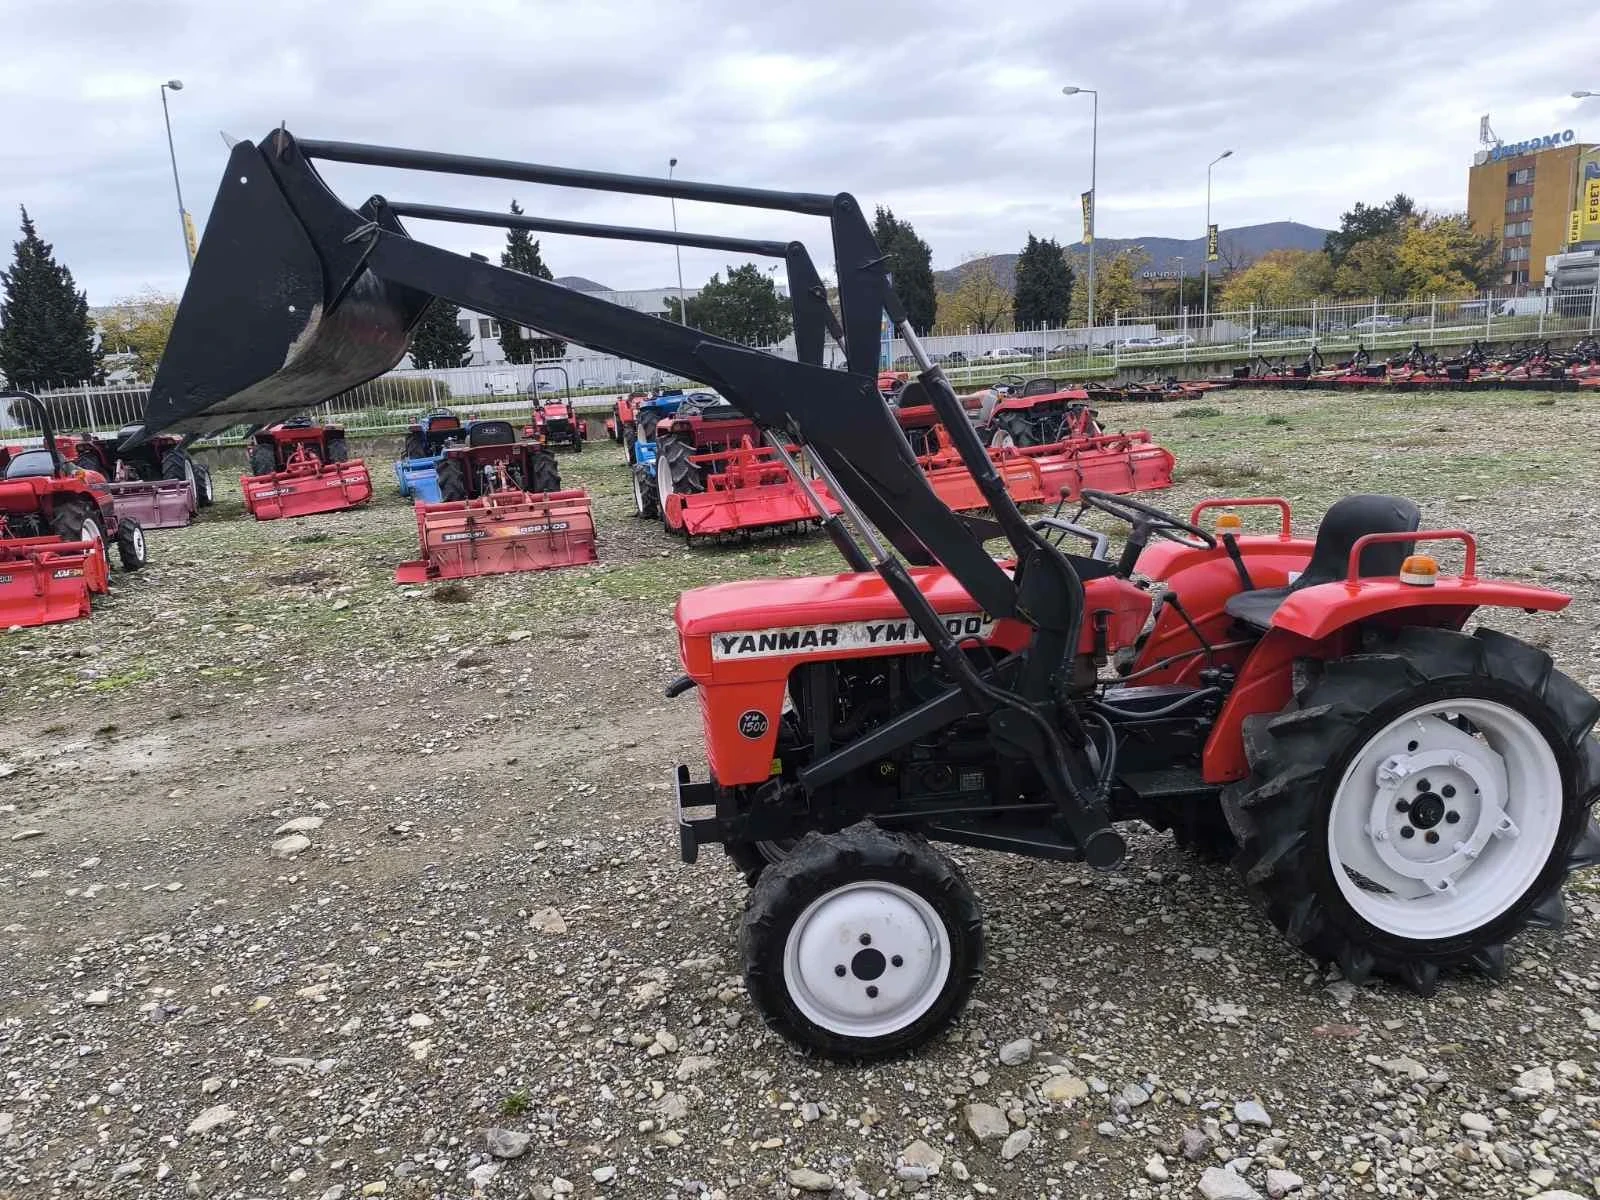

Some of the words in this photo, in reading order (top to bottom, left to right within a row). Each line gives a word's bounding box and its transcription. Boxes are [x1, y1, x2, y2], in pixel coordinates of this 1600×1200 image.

[719, 628, 838, 655] YANMAR
[744, 714, 760, 722] YM
[742, 720, 767, 733] 1500
